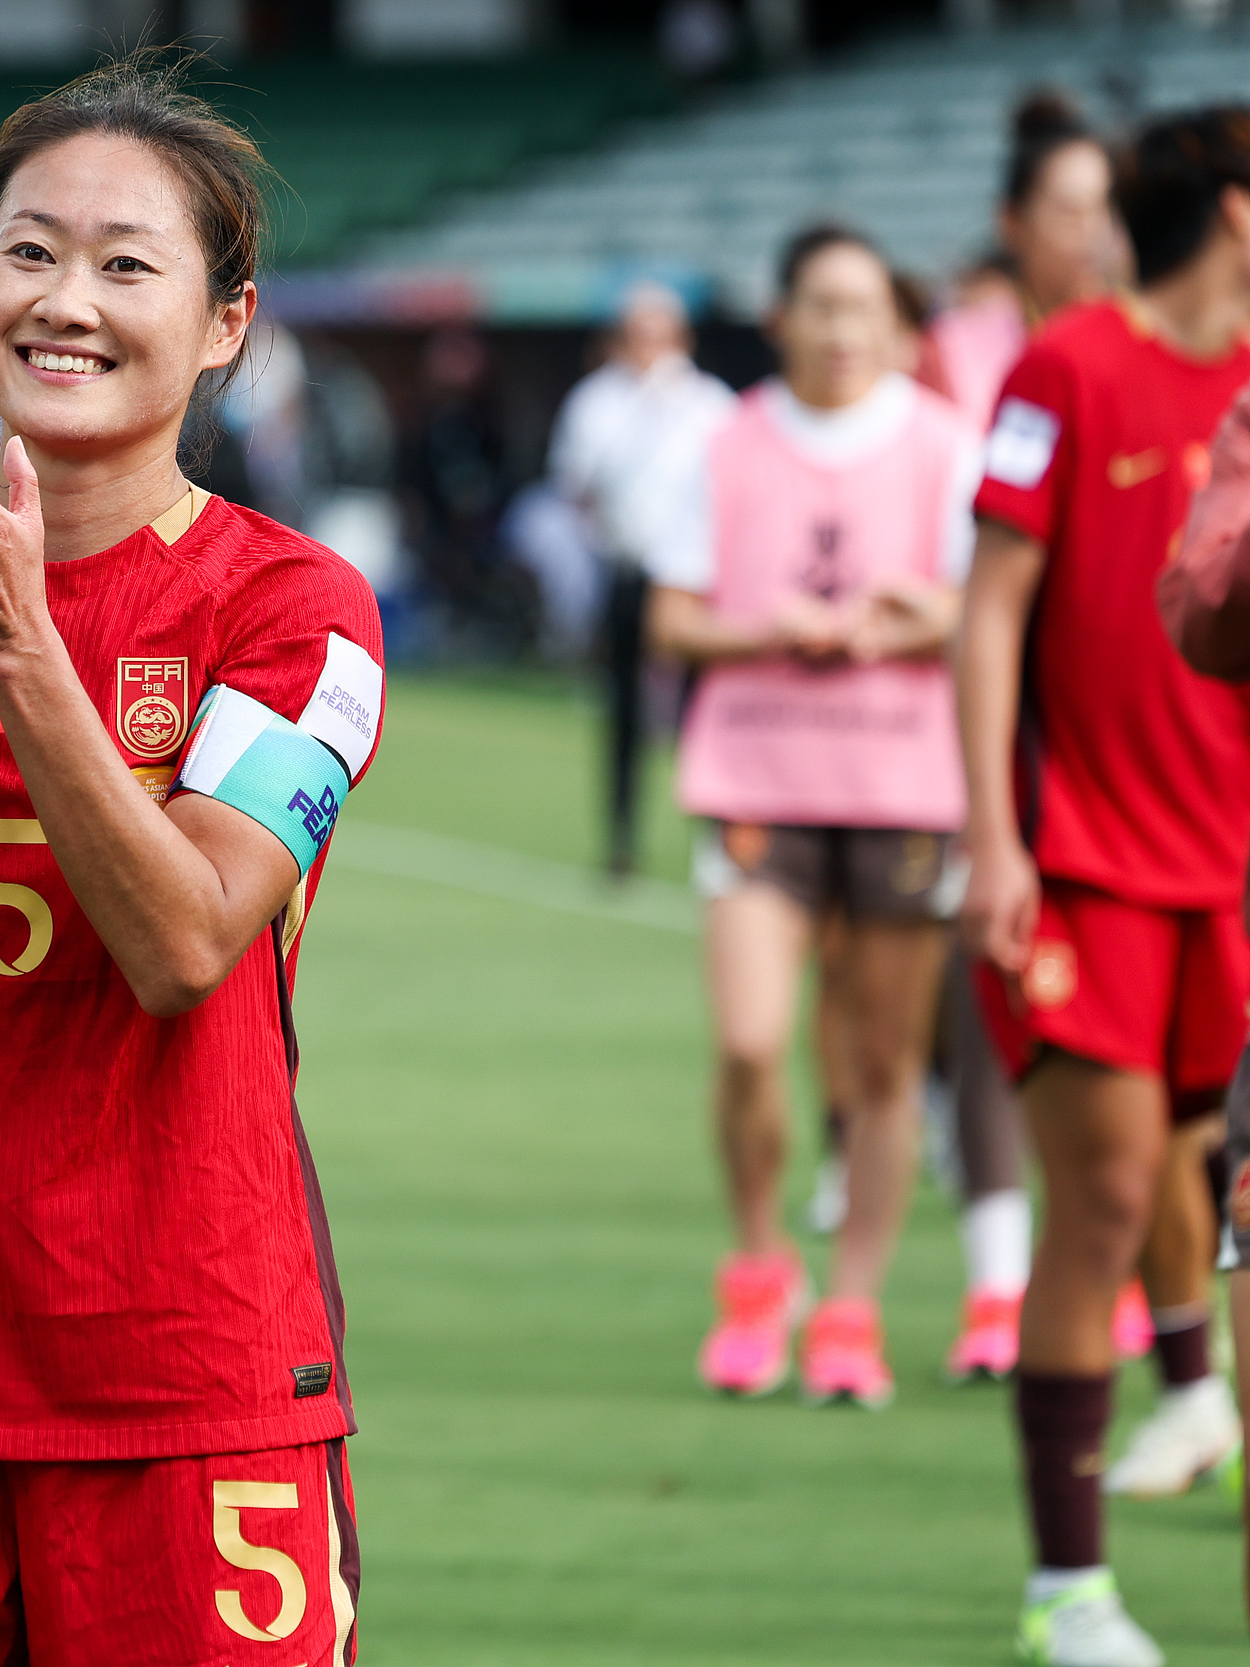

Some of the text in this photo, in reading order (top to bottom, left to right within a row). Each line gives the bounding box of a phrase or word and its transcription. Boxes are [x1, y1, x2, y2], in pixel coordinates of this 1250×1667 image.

[124, 664, 182, 681] CFA
[142, 682, 164, 694] 中国
[318, 689, 372, 739] FEARLESS
[332, 684, 370, 722] DREAM
[213, 1480, 306, 1641] 5
